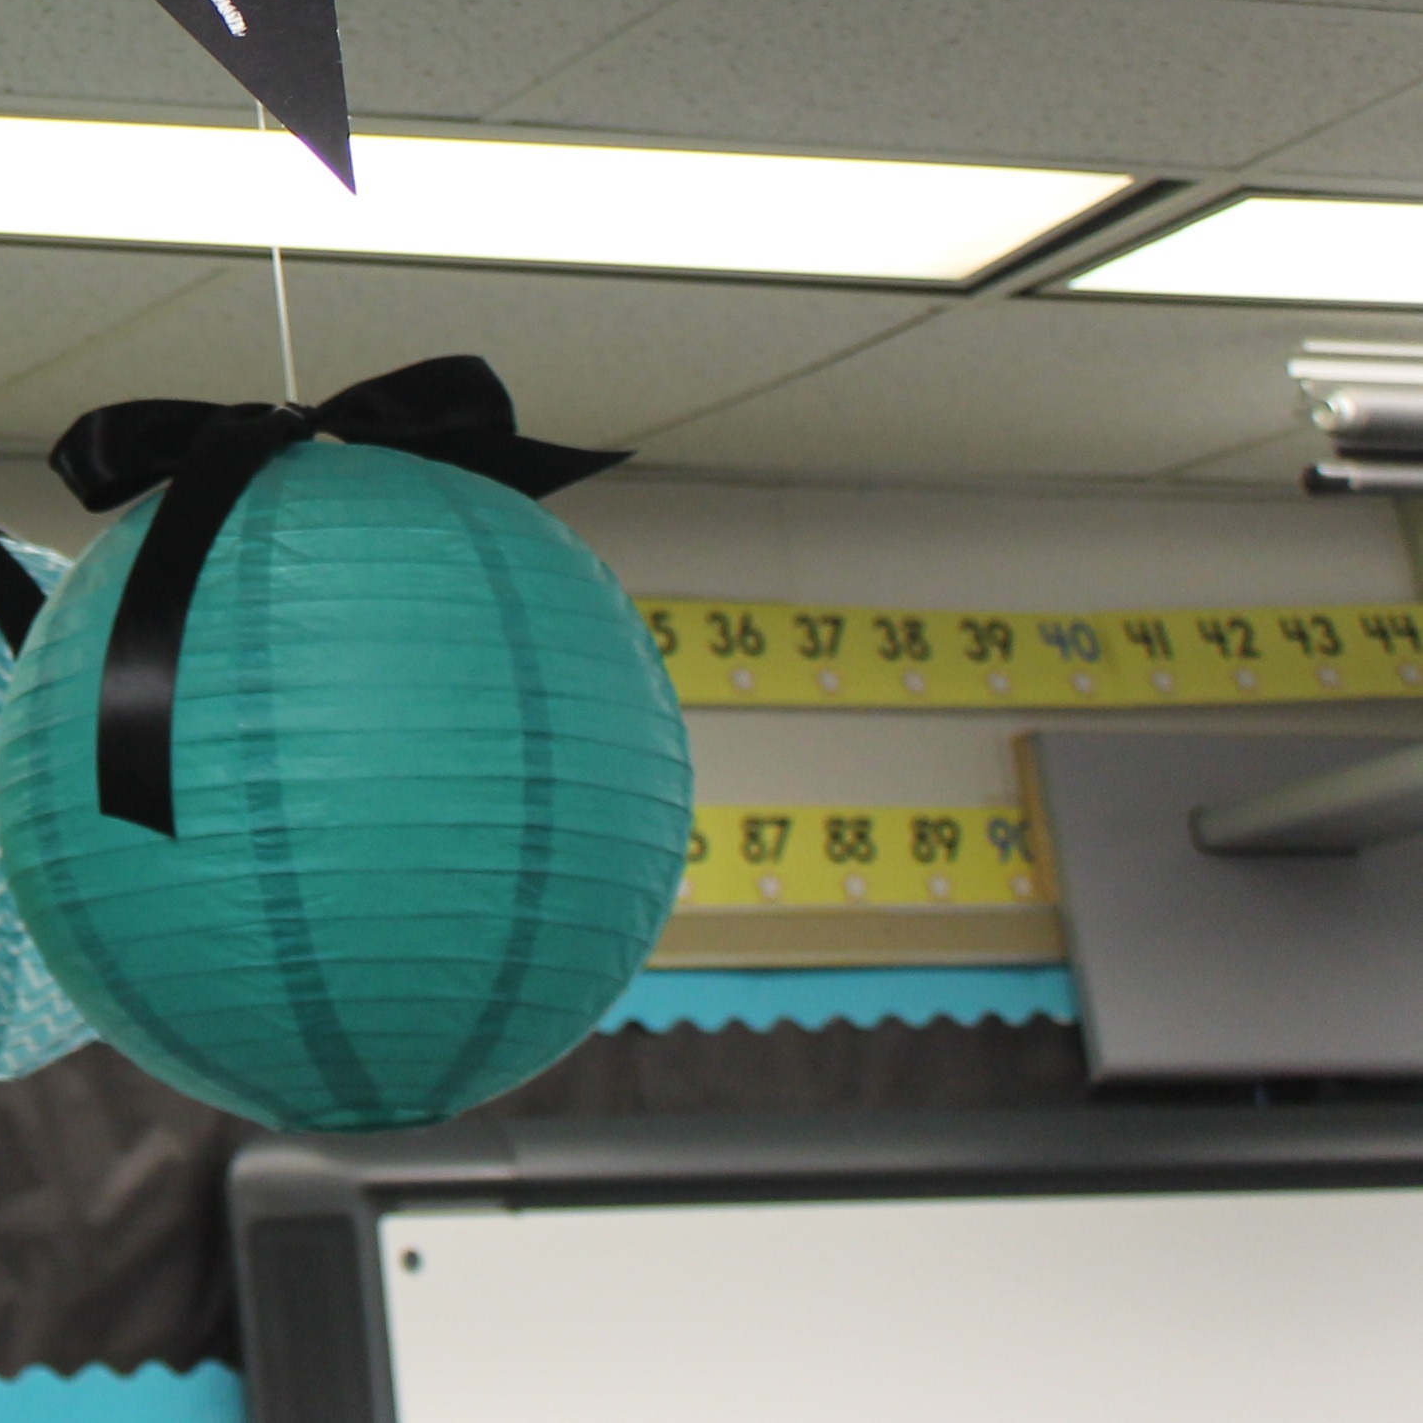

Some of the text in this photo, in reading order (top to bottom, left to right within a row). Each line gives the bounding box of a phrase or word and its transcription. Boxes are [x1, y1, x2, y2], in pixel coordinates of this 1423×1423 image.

[707, 612, 766, 657] 36
[795, 614, 845, 659] 37
[874, 617, 931, 661] 38
[960, 617, 1013, 661] 39
[1038, 619, 1100, 662] 40
[1122, 619, 1174, 660] 41
[1198, 616, 1261, 659] 42
[1278, 614, 1343, 655] 43
[1360, 613, 1422, 654] 44
[742, 816, 791, 863] 87
[825, 816, 877, 863] 88
[911, 816, 961, 862] 89
